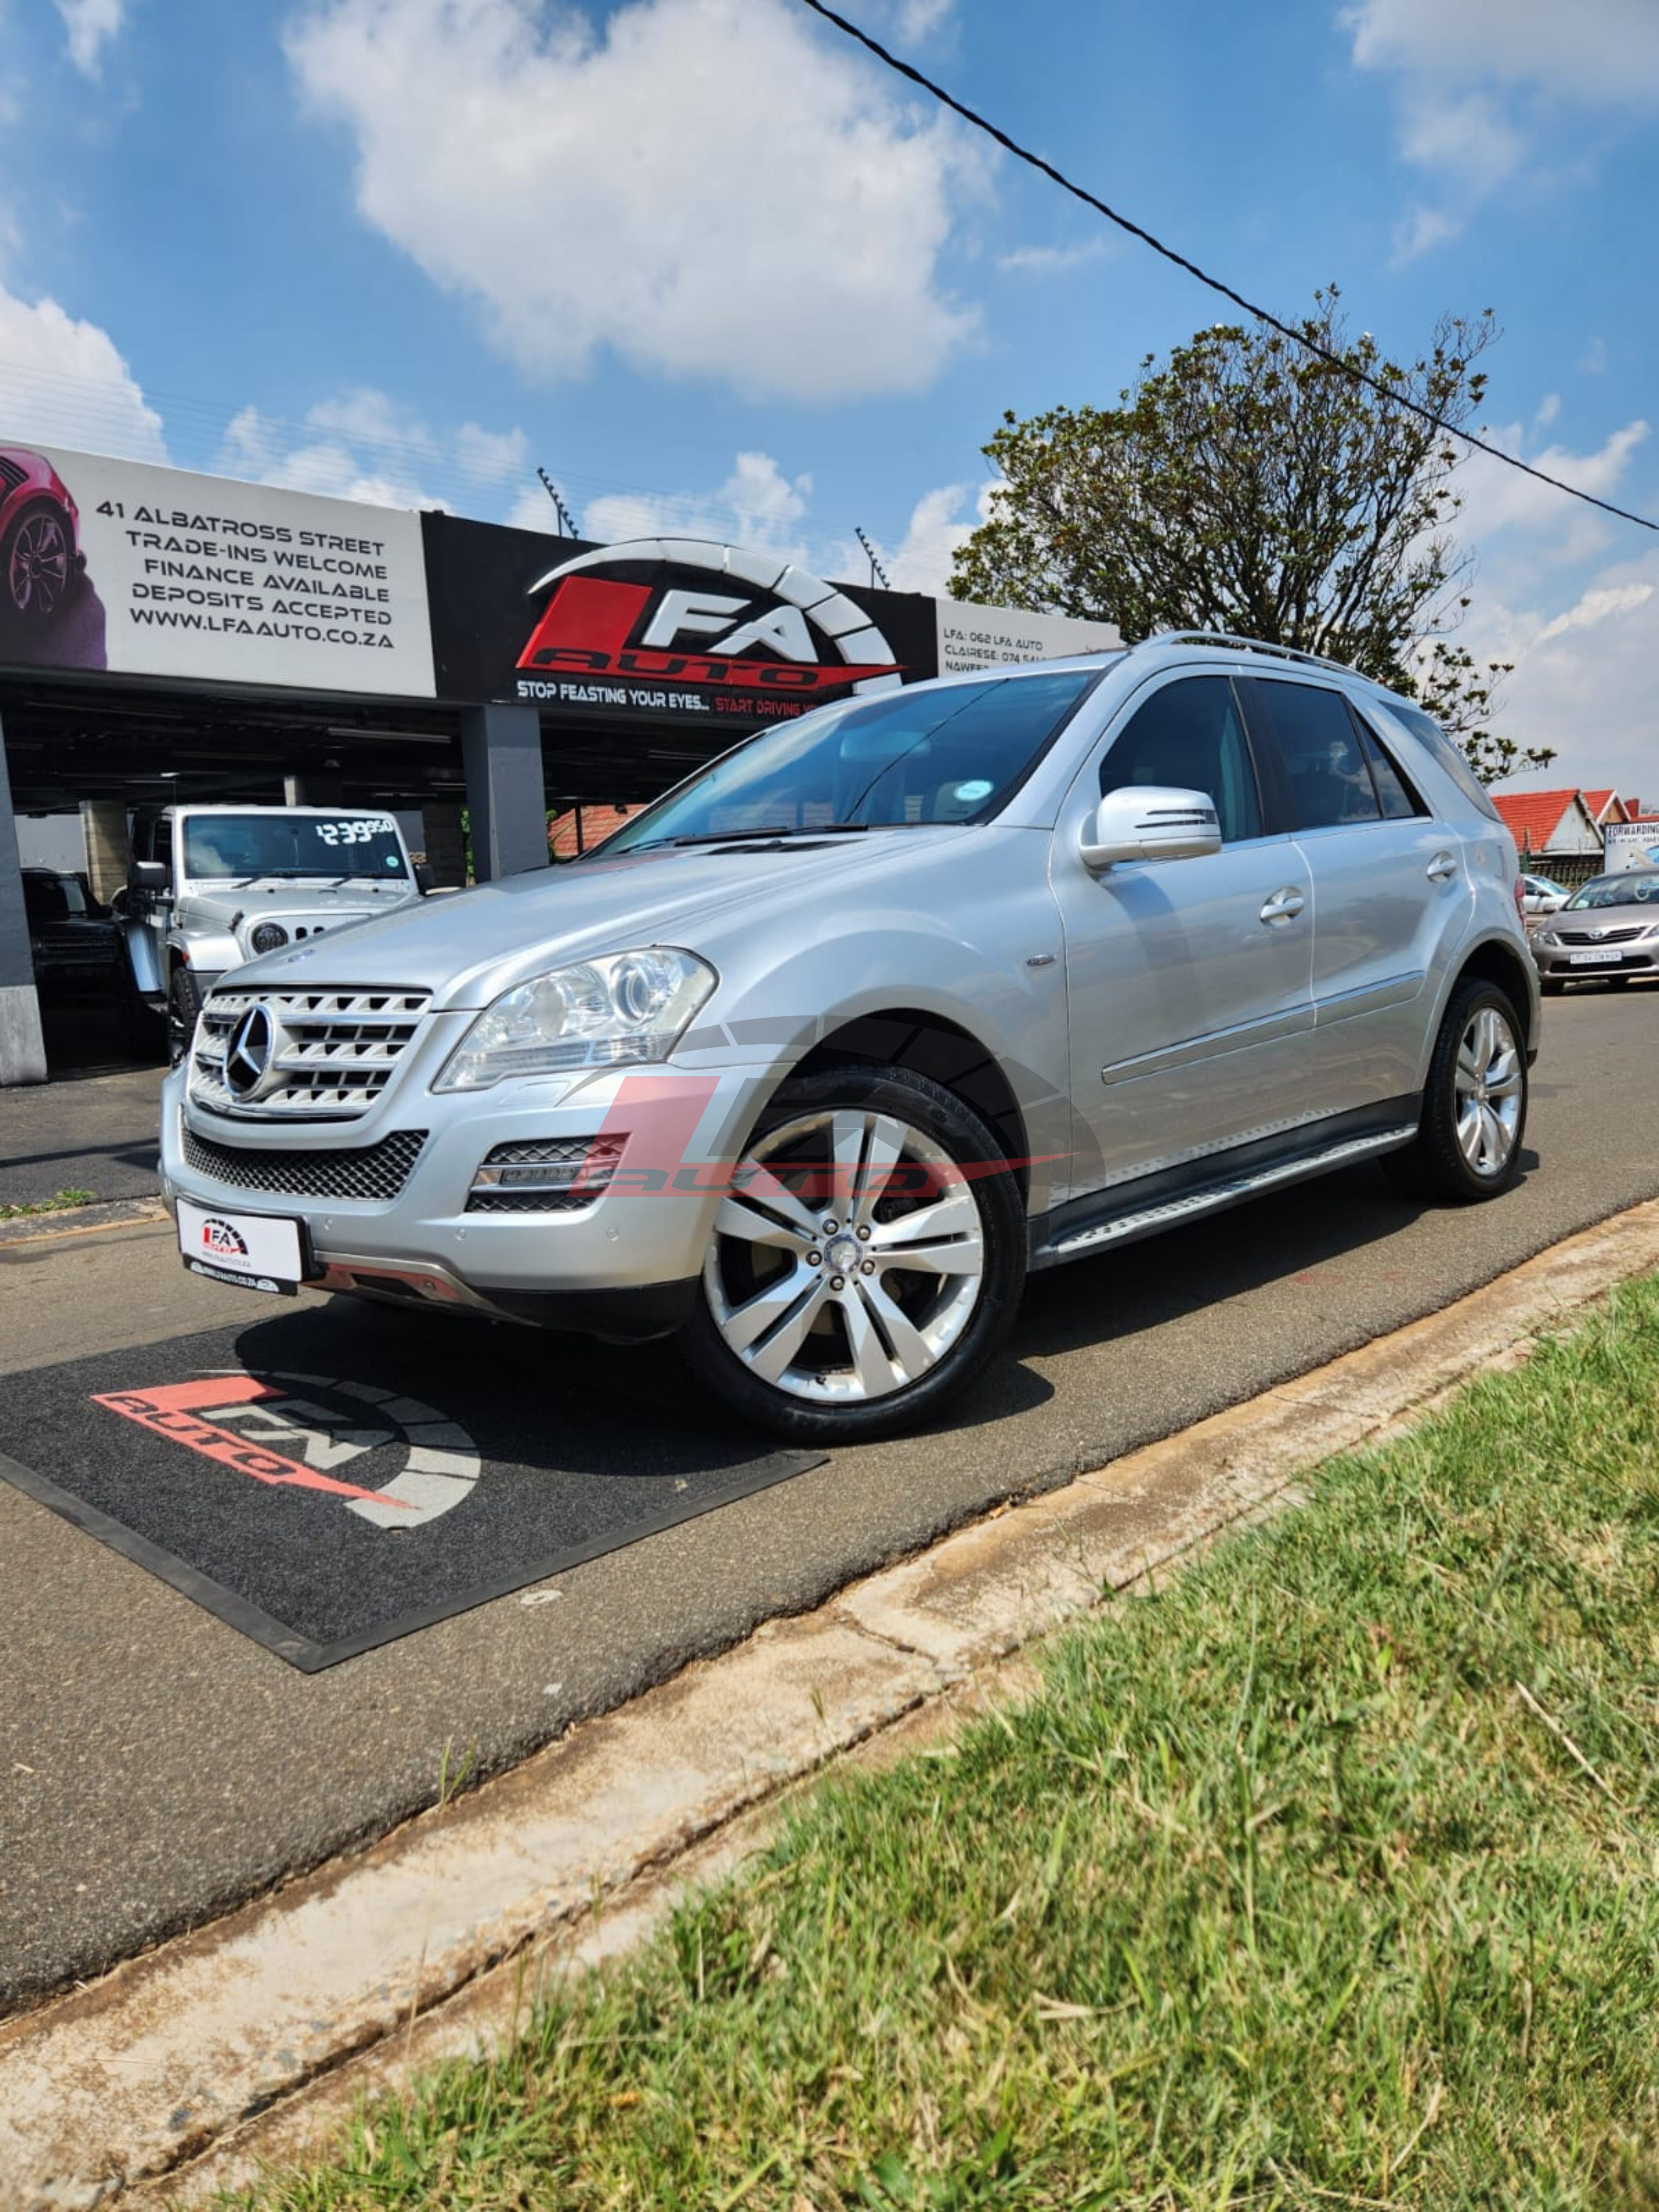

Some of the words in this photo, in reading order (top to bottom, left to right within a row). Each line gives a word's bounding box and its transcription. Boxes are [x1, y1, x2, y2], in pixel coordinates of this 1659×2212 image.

[96, 500, 124, 518] 41
[134, 506, 292, 542] ALBATROSS
[299, 531, 384, 556] STREET
[126, 531, 267, 563] TRADE-INS
[273, 551, 387, 580] WELCOME
[144, 559, 254, 586] FINANCE
[263, 575, 389, 602] AVAILABLE
[132, 583, 263, 611] DEPOSITS
[272, 600, 392, 625] ACCEPTED
[130, 608, 393, 648] WWW.LFAAUTO.CO.ZA
[943, 628, 967, 640] LFA:
[969, 632, 991, 644] 062
[993, 635, 1012, 647] LFA
[1016, 639, 1043, 651] AUTO
[532, 648, 819, 686] AUTO
[1001, 651, 1020, 664] 074
[517, 680, 557, 698] STOP
[560, 684, 626, 704] FEASTING
[629, 689, 666, 707] YOUR
[669, 692, 710, 710] EYES...
[715, 696, 754, 714] START
[756, 700, 800, 716] DRIVING
[104, 1396, 297, 1475] AUTO
